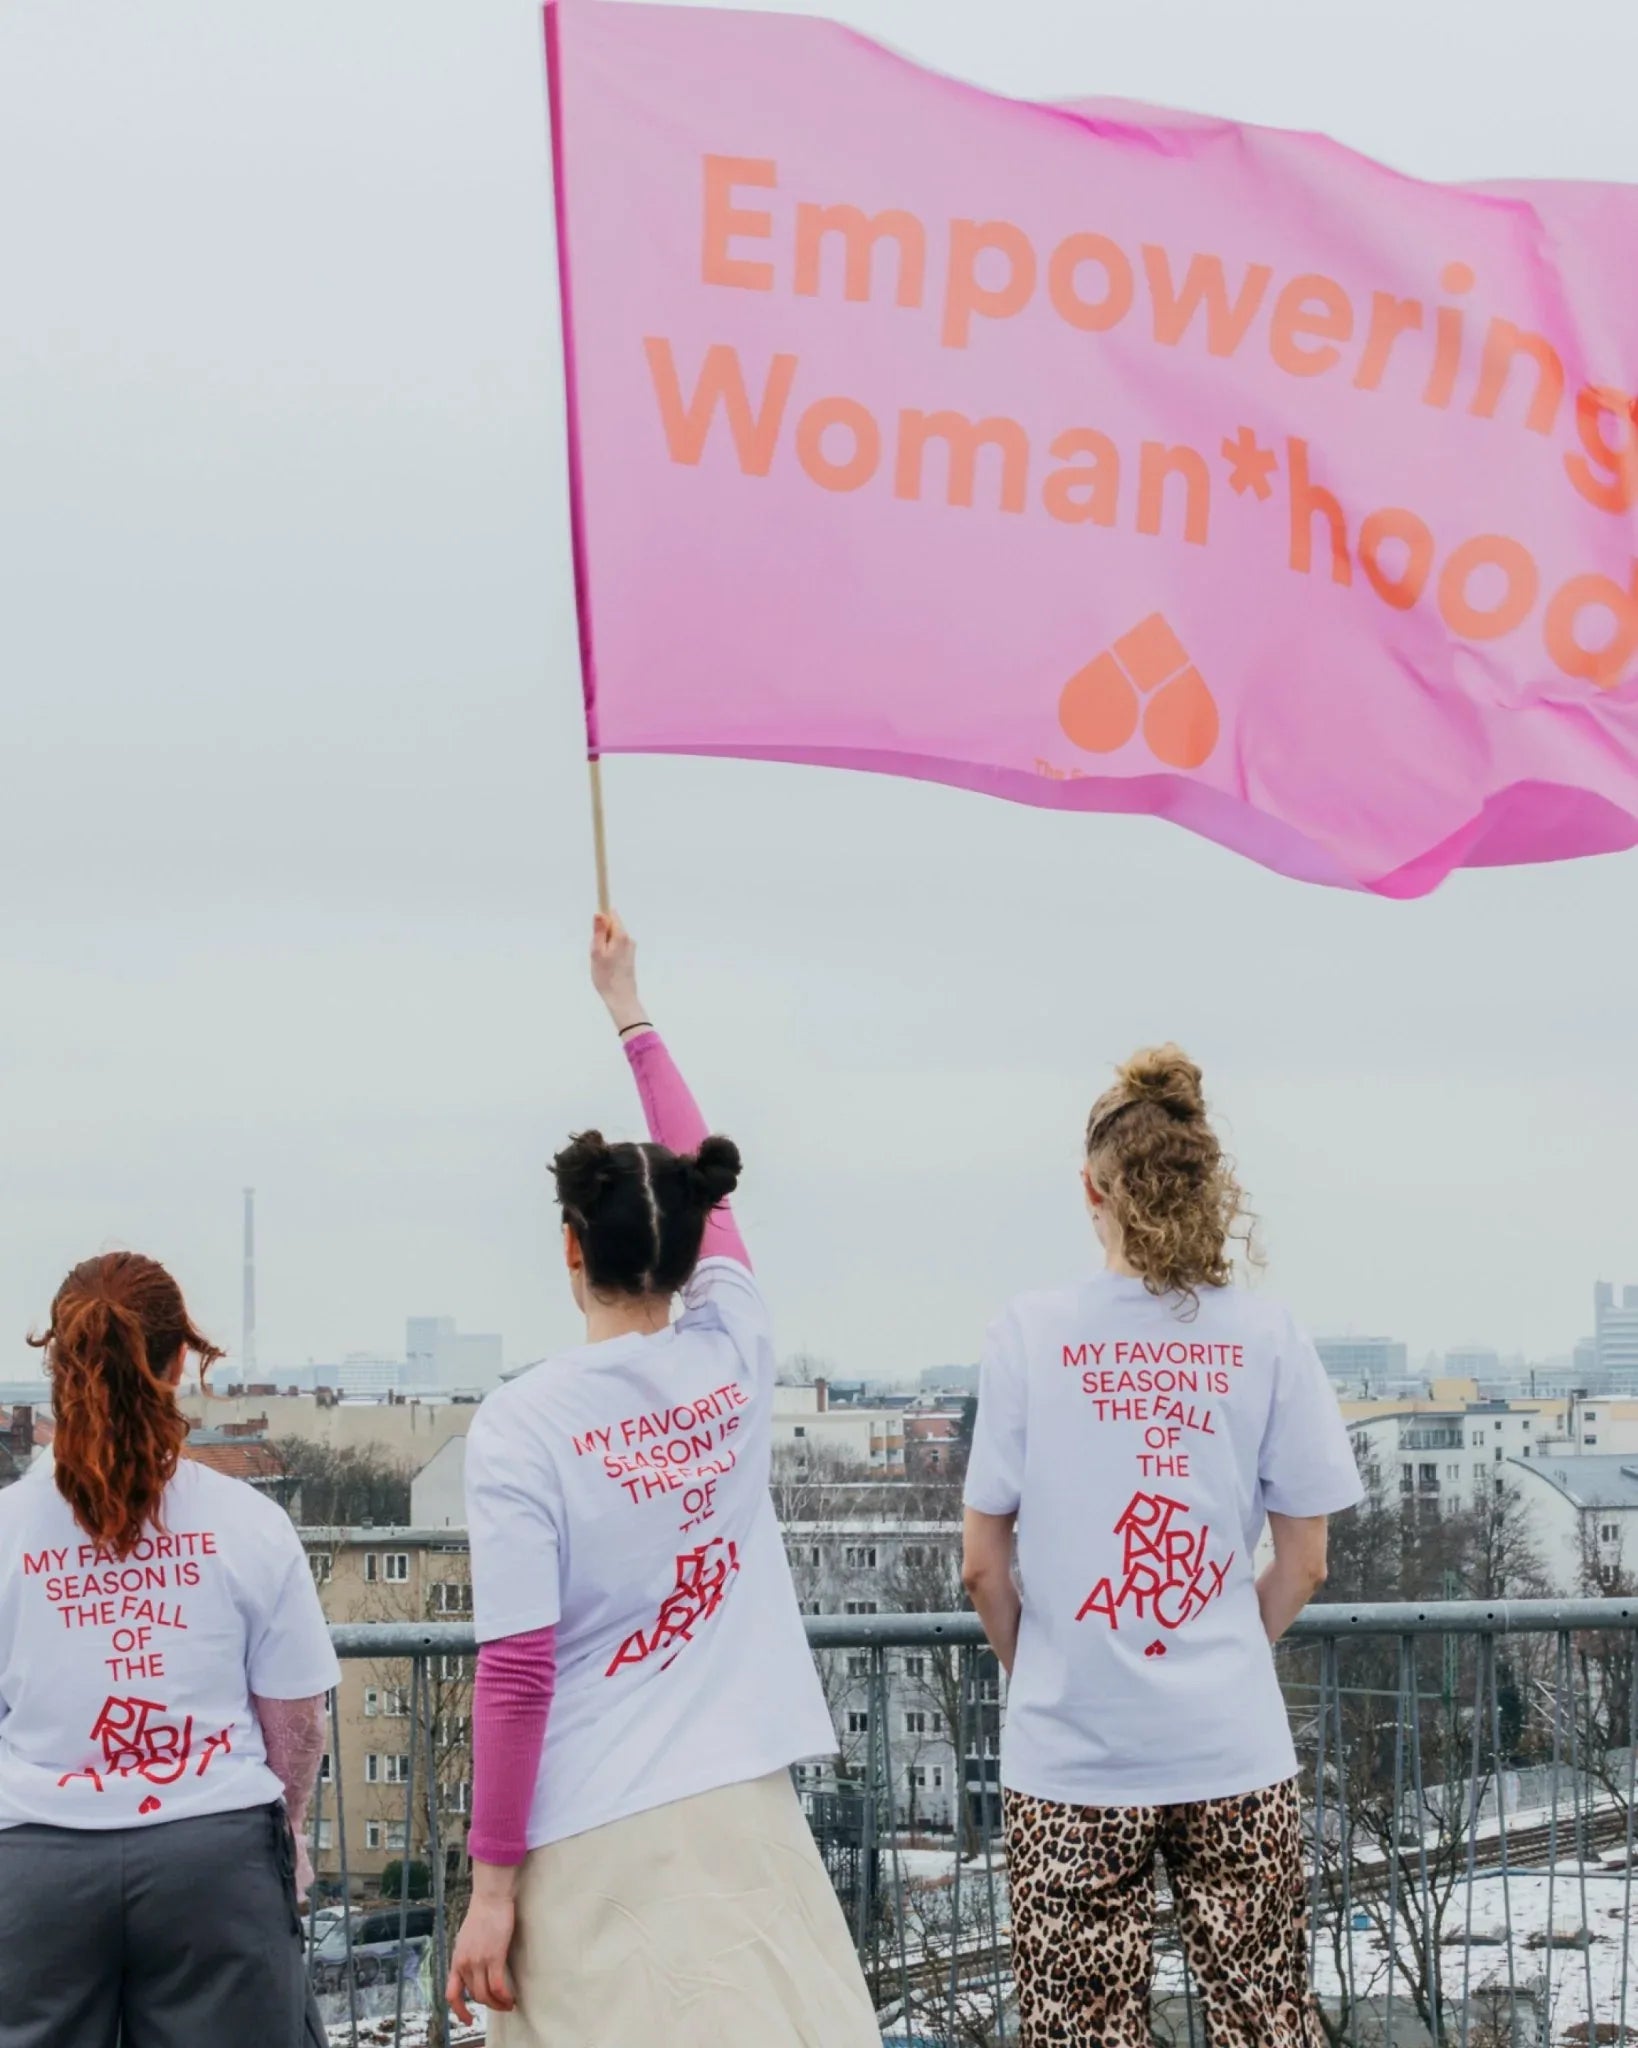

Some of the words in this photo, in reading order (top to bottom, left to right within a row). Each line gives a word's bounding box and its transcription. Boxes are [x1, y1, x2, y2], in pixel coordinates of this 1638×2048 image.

[701, 153, 1638, 515] Empowering
[1063, 1343, 1106, 1367] MY
[1114, 1342, 1244, 1367] FAVORITE
[1082, 1370, 1197, 1393] SEASON
[1206, 1372, 1229, 1394] IS
[571, 1426, 611, 1456] MY
[620, 1383, 749, 1447] FAVORITE
[1092, 1399, 1148, 1421] THE
[1152, 1395, 1216, 1434] FALL
[603, 1431, 713, 1479] SEASON
[719, 1416, 740, 1442] IS
[1144, 1426, 1181, 1450] OF
[1136, 1455, 1190, 1477] THE
[621, 1471, 684, 1505] THE
[683, 1478, 717, 1513] OF
[23, 1547, 68, 1575] MY
[46, 1566, 166, 1602] SEASON
[175, 1562, 200, 1586] IS
[58, 1601, 116, 1628] THE
[120, 1596, 188, 1629] FALL
[112, 1626, 152, 1652] OF
[105, 1653, 164, 1682] THE
